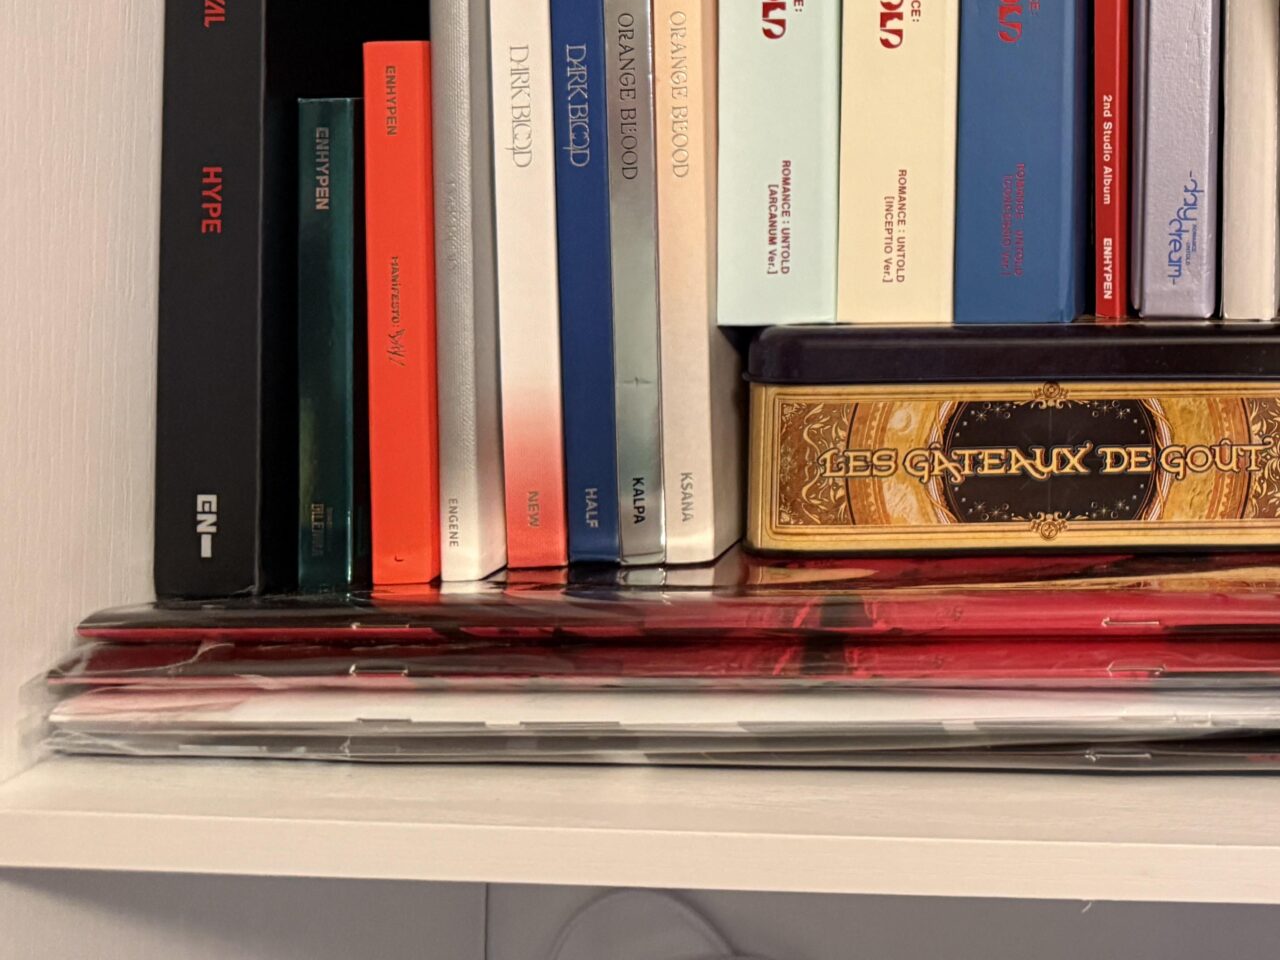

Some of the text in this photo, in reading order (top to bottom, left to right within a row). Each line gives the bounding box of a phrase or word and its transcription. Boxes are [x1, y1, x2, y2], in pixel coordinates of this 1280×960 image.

[509, 45, 530, 99] DARK
[566, 44, 588, 100] DARK
[618, 12, 638, 180] ORANGE BLOOD
[669, 11, 689, 178] ORANGE BLOOD
[385, 65, 398, 136] ENHYPEN
[315, 127, 330, 210] ENHYPEN
[781, 160, 791, 217] ROMANCE
[1103, 94, 1113, 299] 2nd Studio Album ENHYPEN
[201, 166, 223, 234] HYPE
[897, 169, 907, 226] ROMANCE
[767, 184, 778, 275] [ARCANUM Ver.]
[780, 227, 791, 274] UNTOLD
[882, 196, 895, 283] [INCEPTIO Ver.]
[896, 236, 906, 283] UNTOLD
[817, 435, 1275, 485] LES GÂTEAUX DE GOÛT
[448, 498, 459, 547] ENGENE
[527, 491, 539, 528] NEW
[585, 487, 598, 529] HALF
[632, 477, 646, 524] KALPA
[680, 472, 694, 522] KSANA
